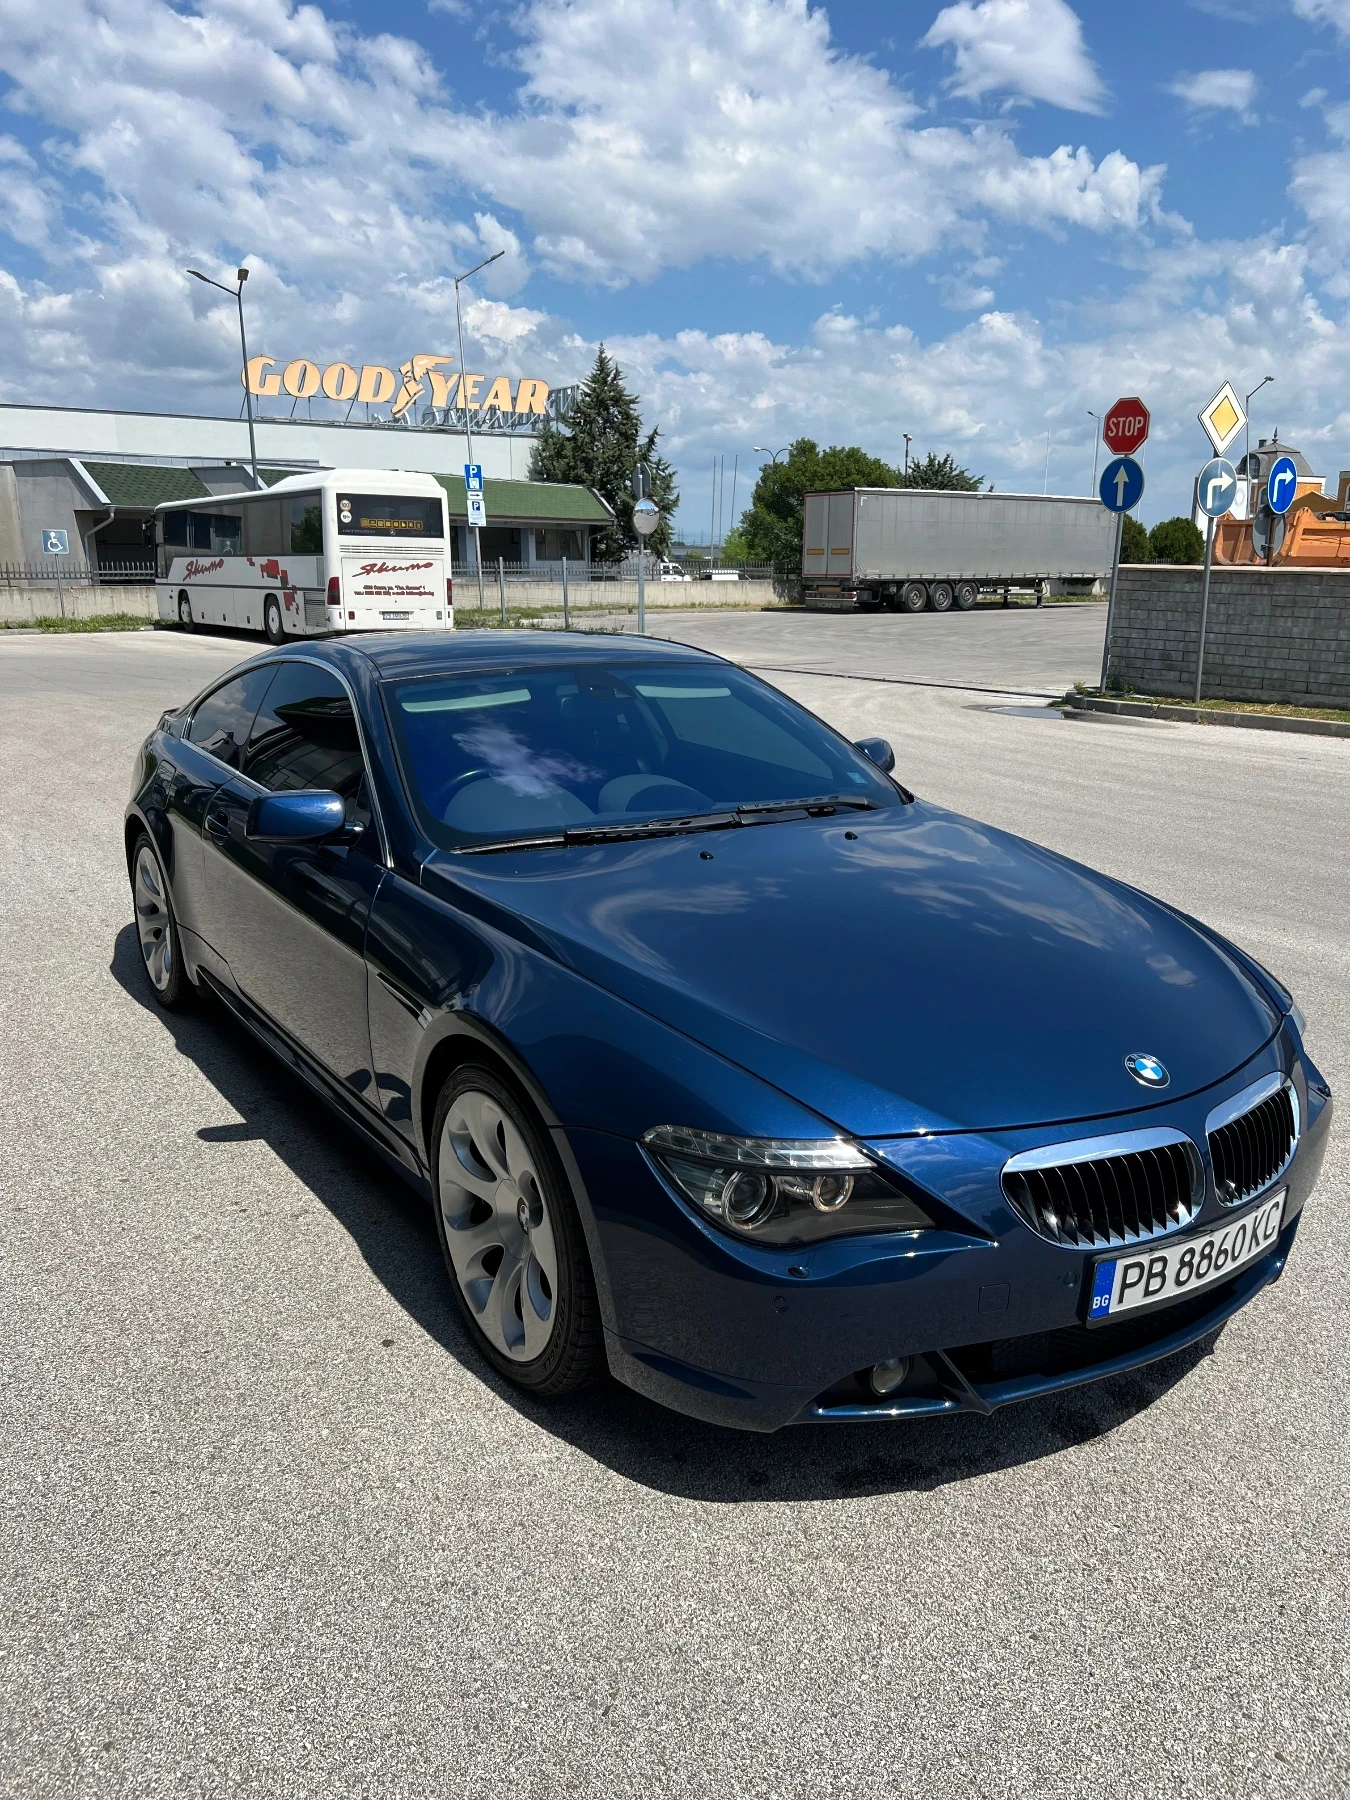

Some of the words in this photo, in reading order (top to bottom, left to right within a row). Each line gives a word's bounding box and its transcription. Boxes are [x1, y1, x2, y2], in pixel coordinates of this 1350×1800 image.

[1107, 416, 1144, 437] STOP
[469, 465, 478, 478] P
[473, 502, 479, 511] P
[816, 601, 841, 609] SCANIA
[1116, 1254, 1169, 1305] PB
[1174, 1223, 1247, 1287] 8860
[1247, 1200, 1280, 1254] KC
[1092, 1294, 1110, 1309] BG
